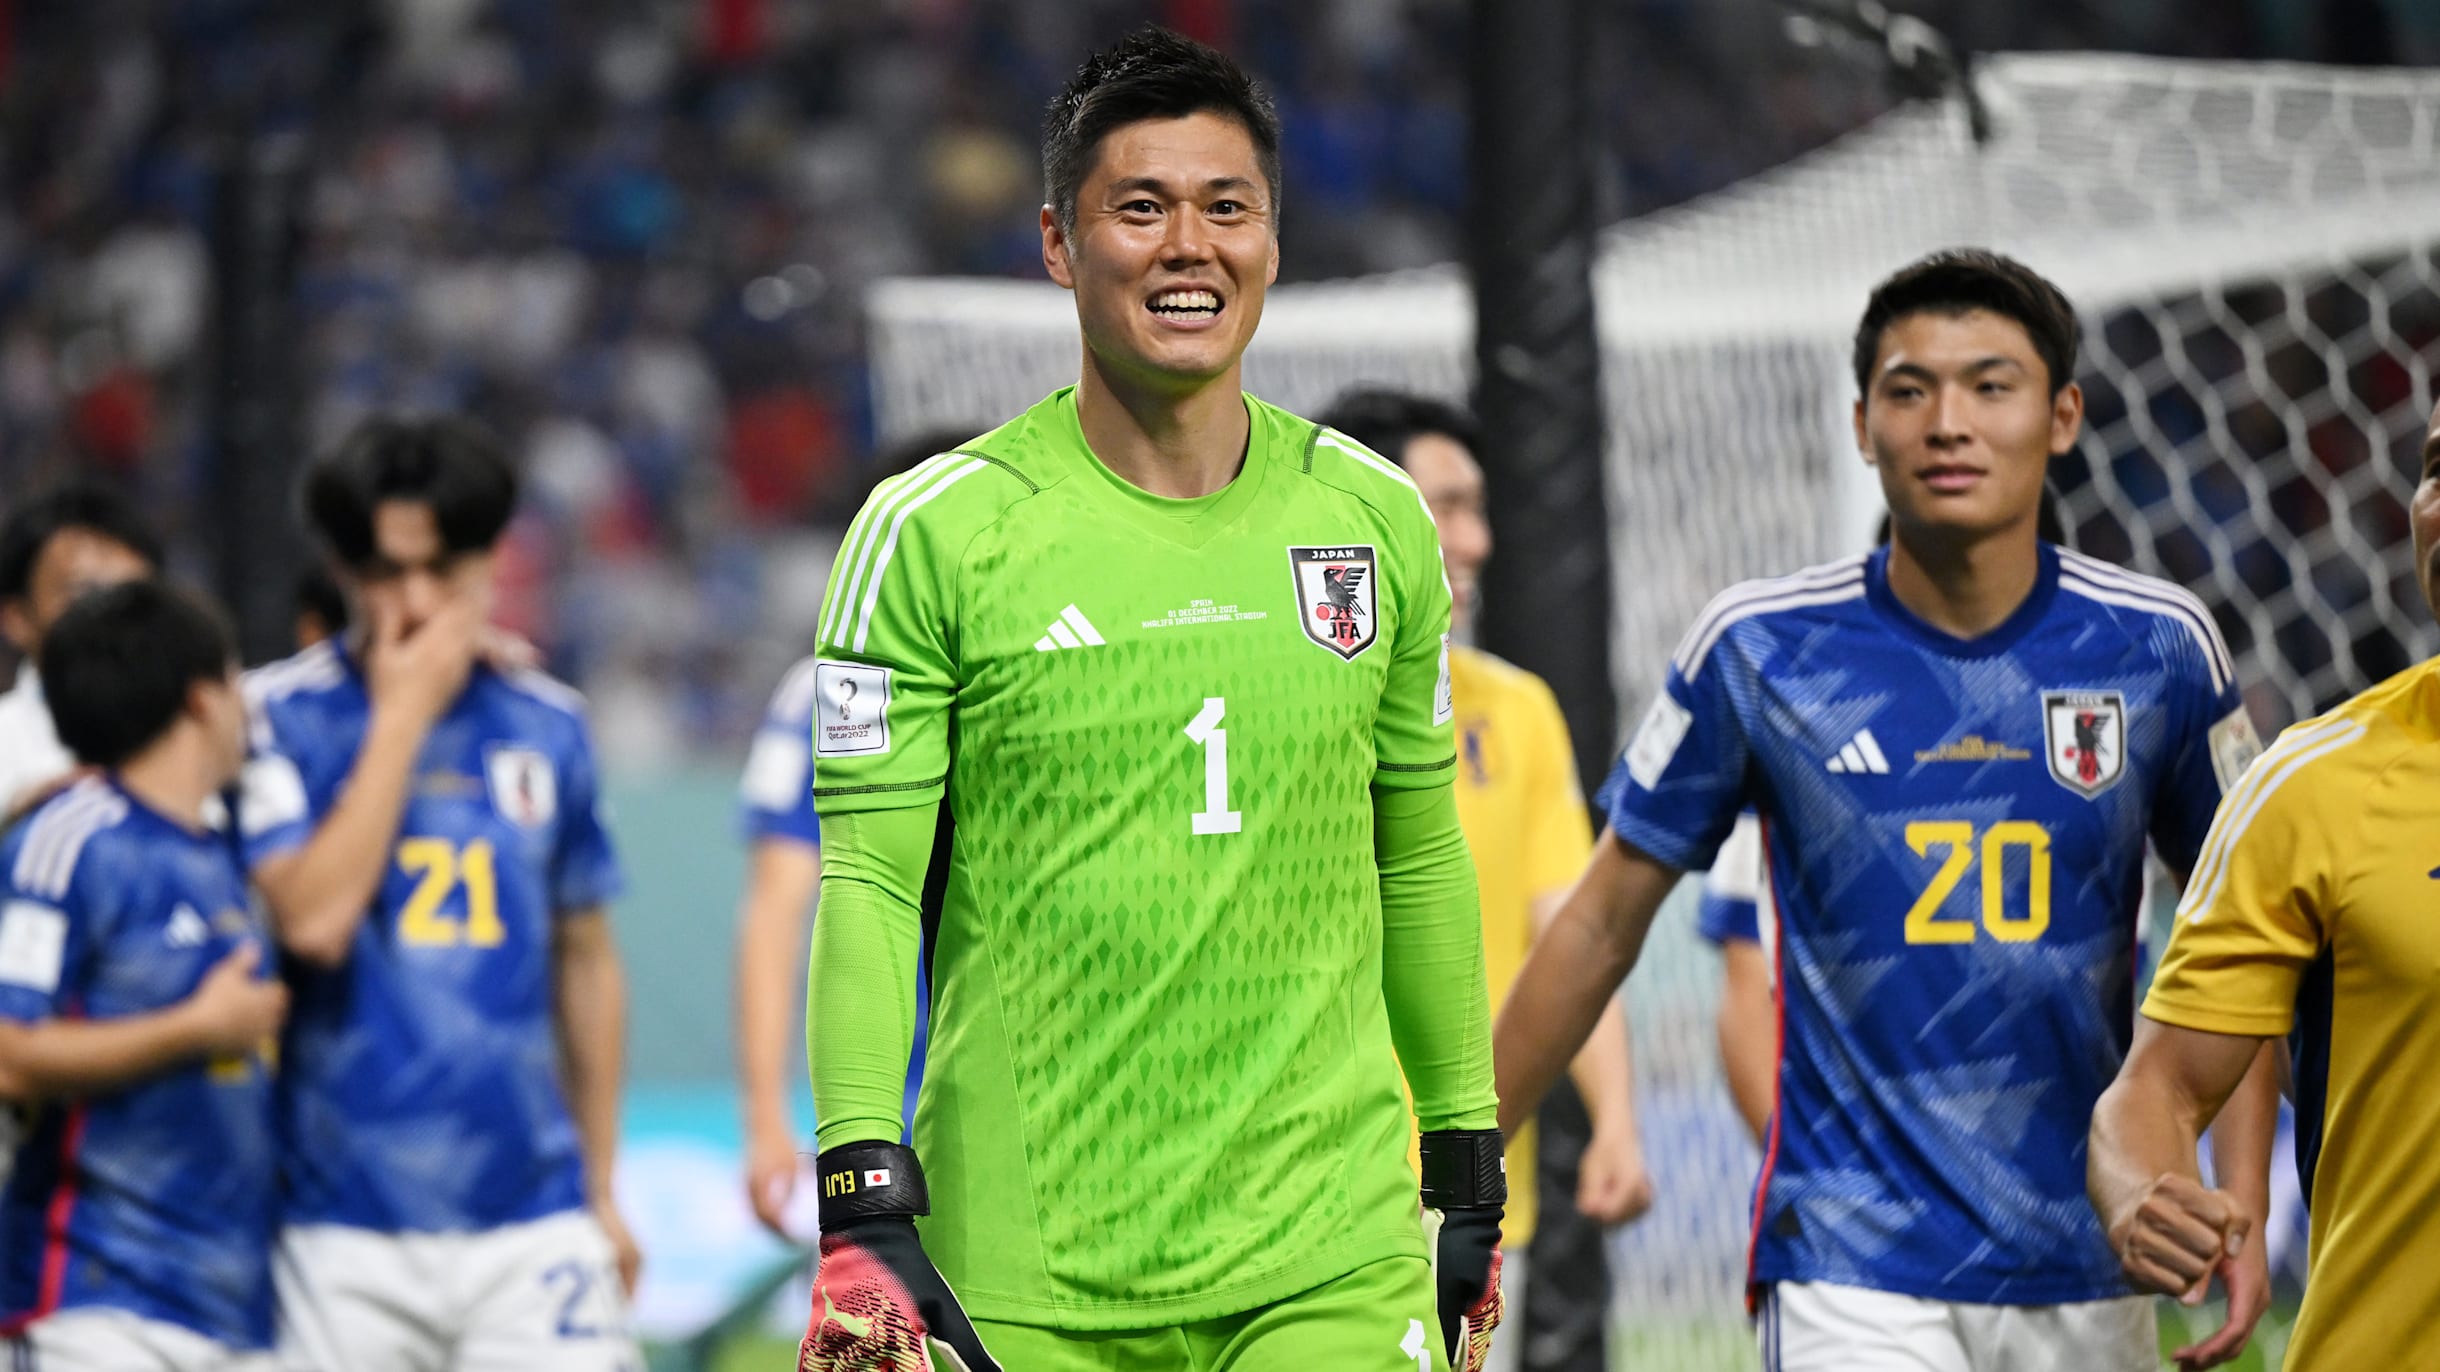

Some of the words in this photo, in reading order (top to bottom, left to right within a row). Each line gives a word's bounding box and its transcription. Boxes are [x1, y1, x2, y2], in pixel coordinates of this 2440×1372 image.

[1312, 549, 1355, 559] JAPAN
[1178, 607, 1217, 617] DECEMBER
[1219, 605, 1238, 614] 2022
[1190, 599, 1213, 608] SPAIN
[1142, 619, 1174, 629] KHALIFA
[1175, 614, 1232, 626] INTERNATIONAL
[1234, 611, 1267, 621] STADIUM
[1328, 622, 1361, 639] JFA
[1184, 697, 1242, 835] 1
[1905, 820, 2050, 945] 20
[396, 836, 506, 949] 21
[825, 1170, 856, 1198] EIJI
